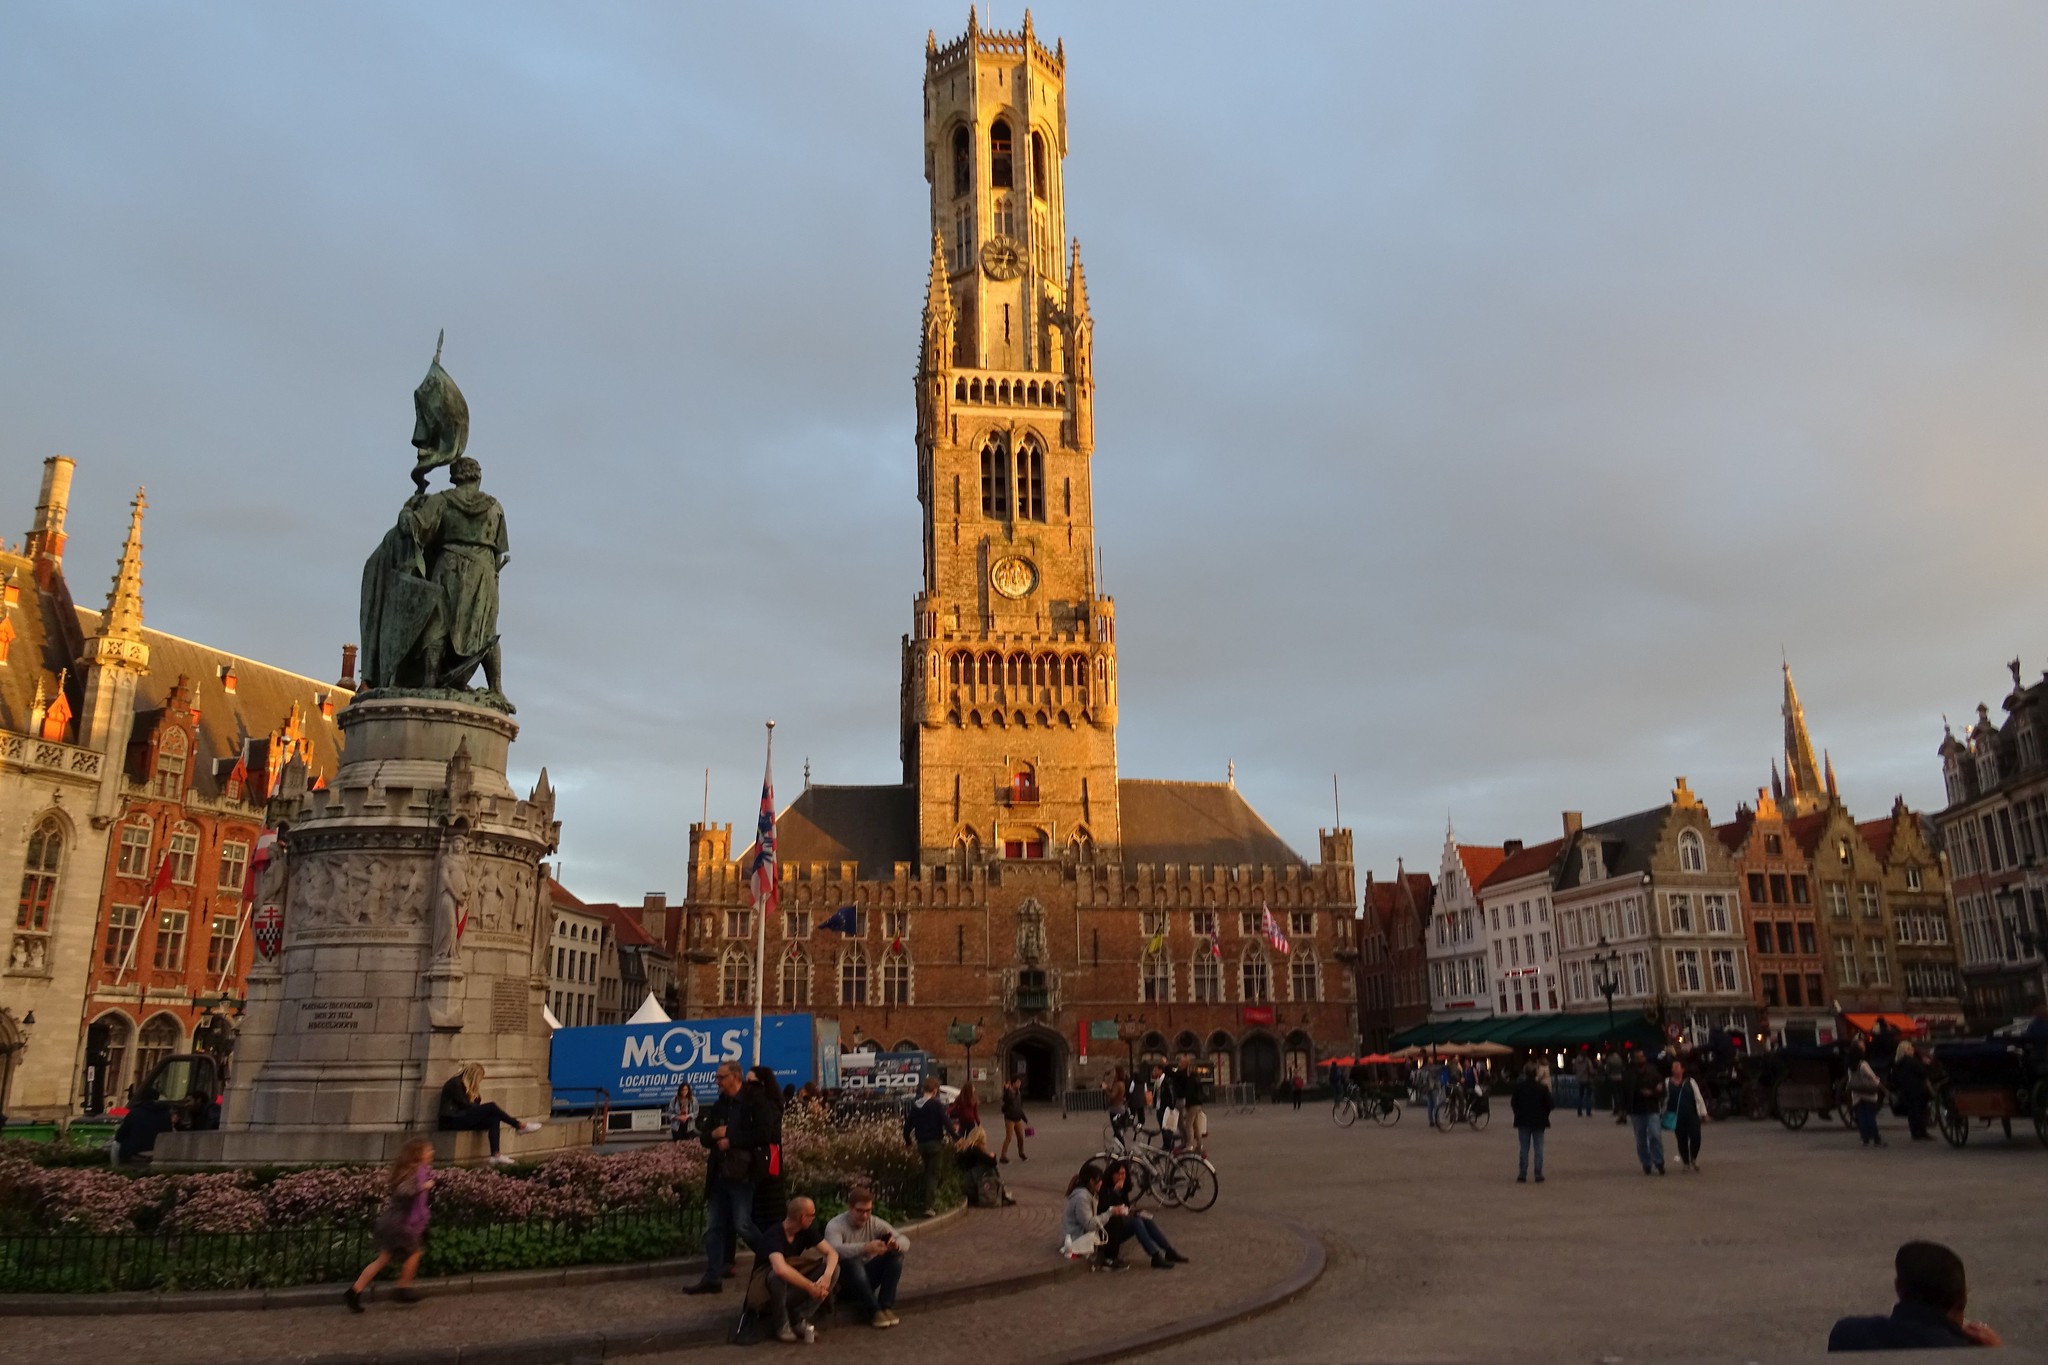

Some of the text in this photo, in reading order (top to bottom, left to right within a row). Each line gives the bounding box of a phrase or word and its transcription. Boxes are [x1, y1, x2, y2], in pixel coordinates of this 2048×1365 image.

[621, 1026, 743, 1072] MOLS
[619, 1071, 718, 1088] LOCATION DE VEHIC
